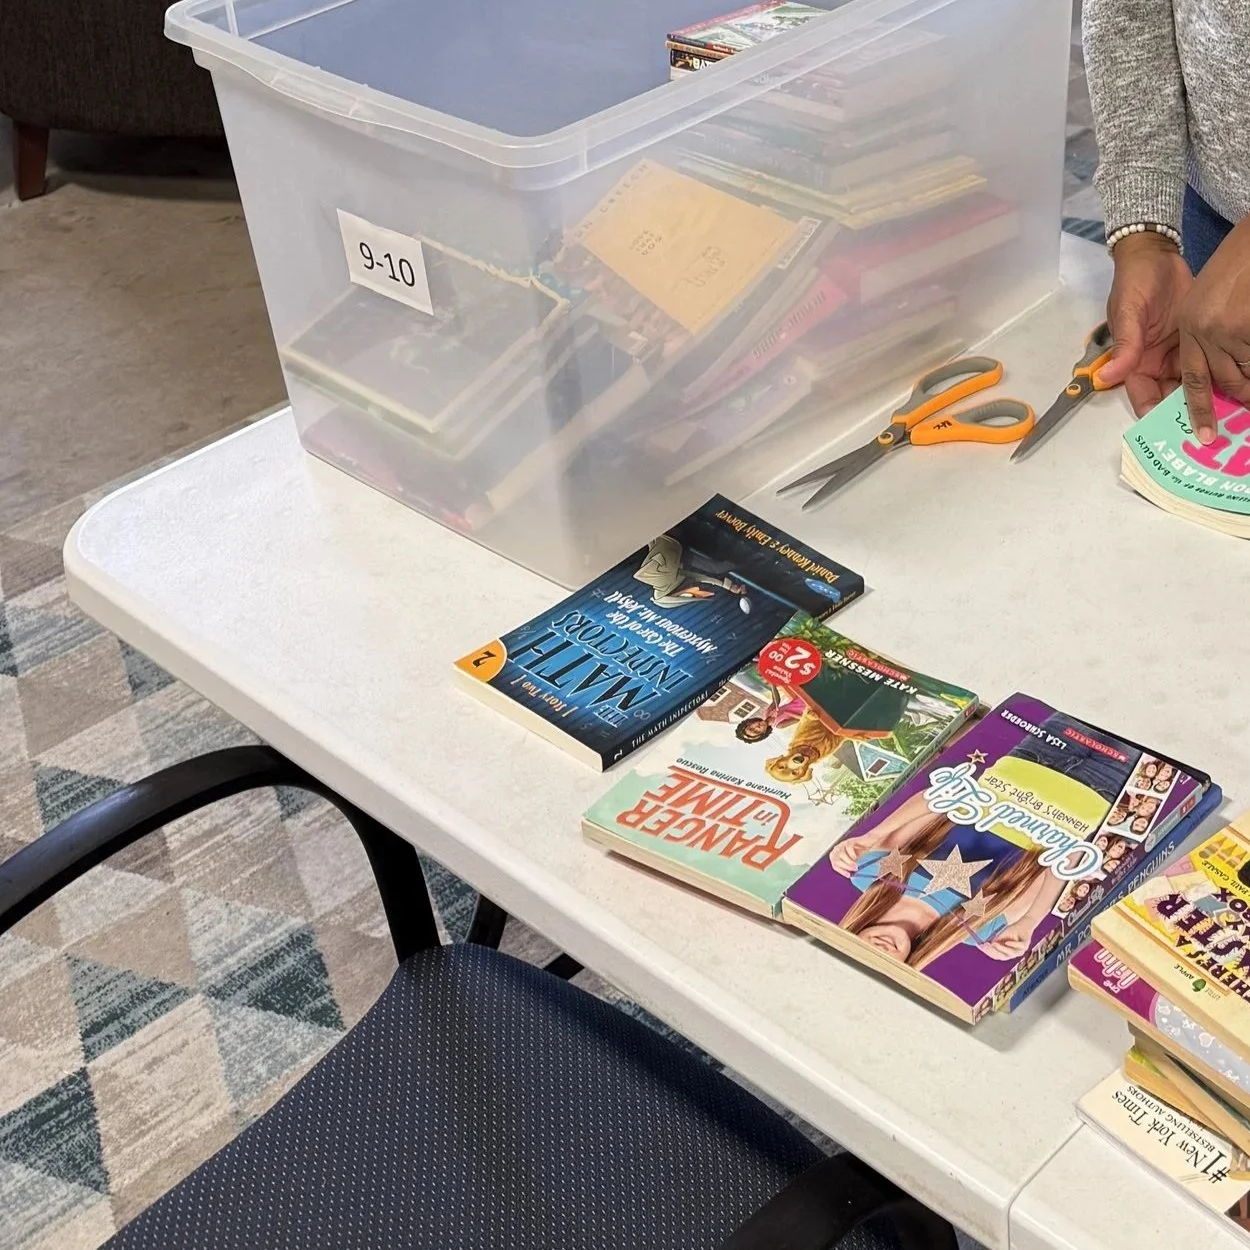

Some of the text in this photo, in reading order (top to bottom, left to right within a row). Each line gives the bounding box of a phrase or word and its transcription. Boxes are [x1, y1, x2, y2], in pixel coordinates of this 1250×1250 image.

[357, 239, 417, 290] 9-10
[1135, 434, 1155, 462] GUYS
[1153, 438, 1218, 487] BLABEY
[1152, 458, 1171, 478] BAD
[746, 524, 769, 547] Emily
[805, 563, 841, 585] Daniel
[604, 590, 643, 614] Jekyll
[551, 608, 695, 694] INSPECTORS
[657, 618, 719, 655] Mysterious
[472, 649, 497, 669] 2
[508, 626, 663, 713] MATH
[824, 648, 919, 696] KATE MESSNER
[521, 681, 568, 713] Story Two
[593, 703, 629, 728] THE
[999, 708, 1068, 751] LISA SCHROEDER
[630, 734, 647, 750] THE
[647, 718, 669, 738] MATH
[1062, 727, 1120, 761] SCHOLASTIC
[675, 756, 710, 777] Rescue
[710, 769, 744, 787] Katrina
[641, 772, 767, 828] TIME
[930, 763, 991, 823] Life
[983, 774, 1012, 794] Star
[1011, 786, 1045, 812] Bright
[752, 809, 779, 827] in
[615, 798, 805, 873] RANGER
[988, 802, 1101, 880] Charmed
[1127, 840, 1176, 896] PENGUINS
[1201, 859, 1231, 883] CASALE
[1229, 878, 1250, 897] PAUL
[1173, 963, 1196, 982] APPLE
[1125, 1085, 1216, 1153] BESTSELLING AUTHORS
[1111, 1090, 1232, 1185] #1 New York Times
